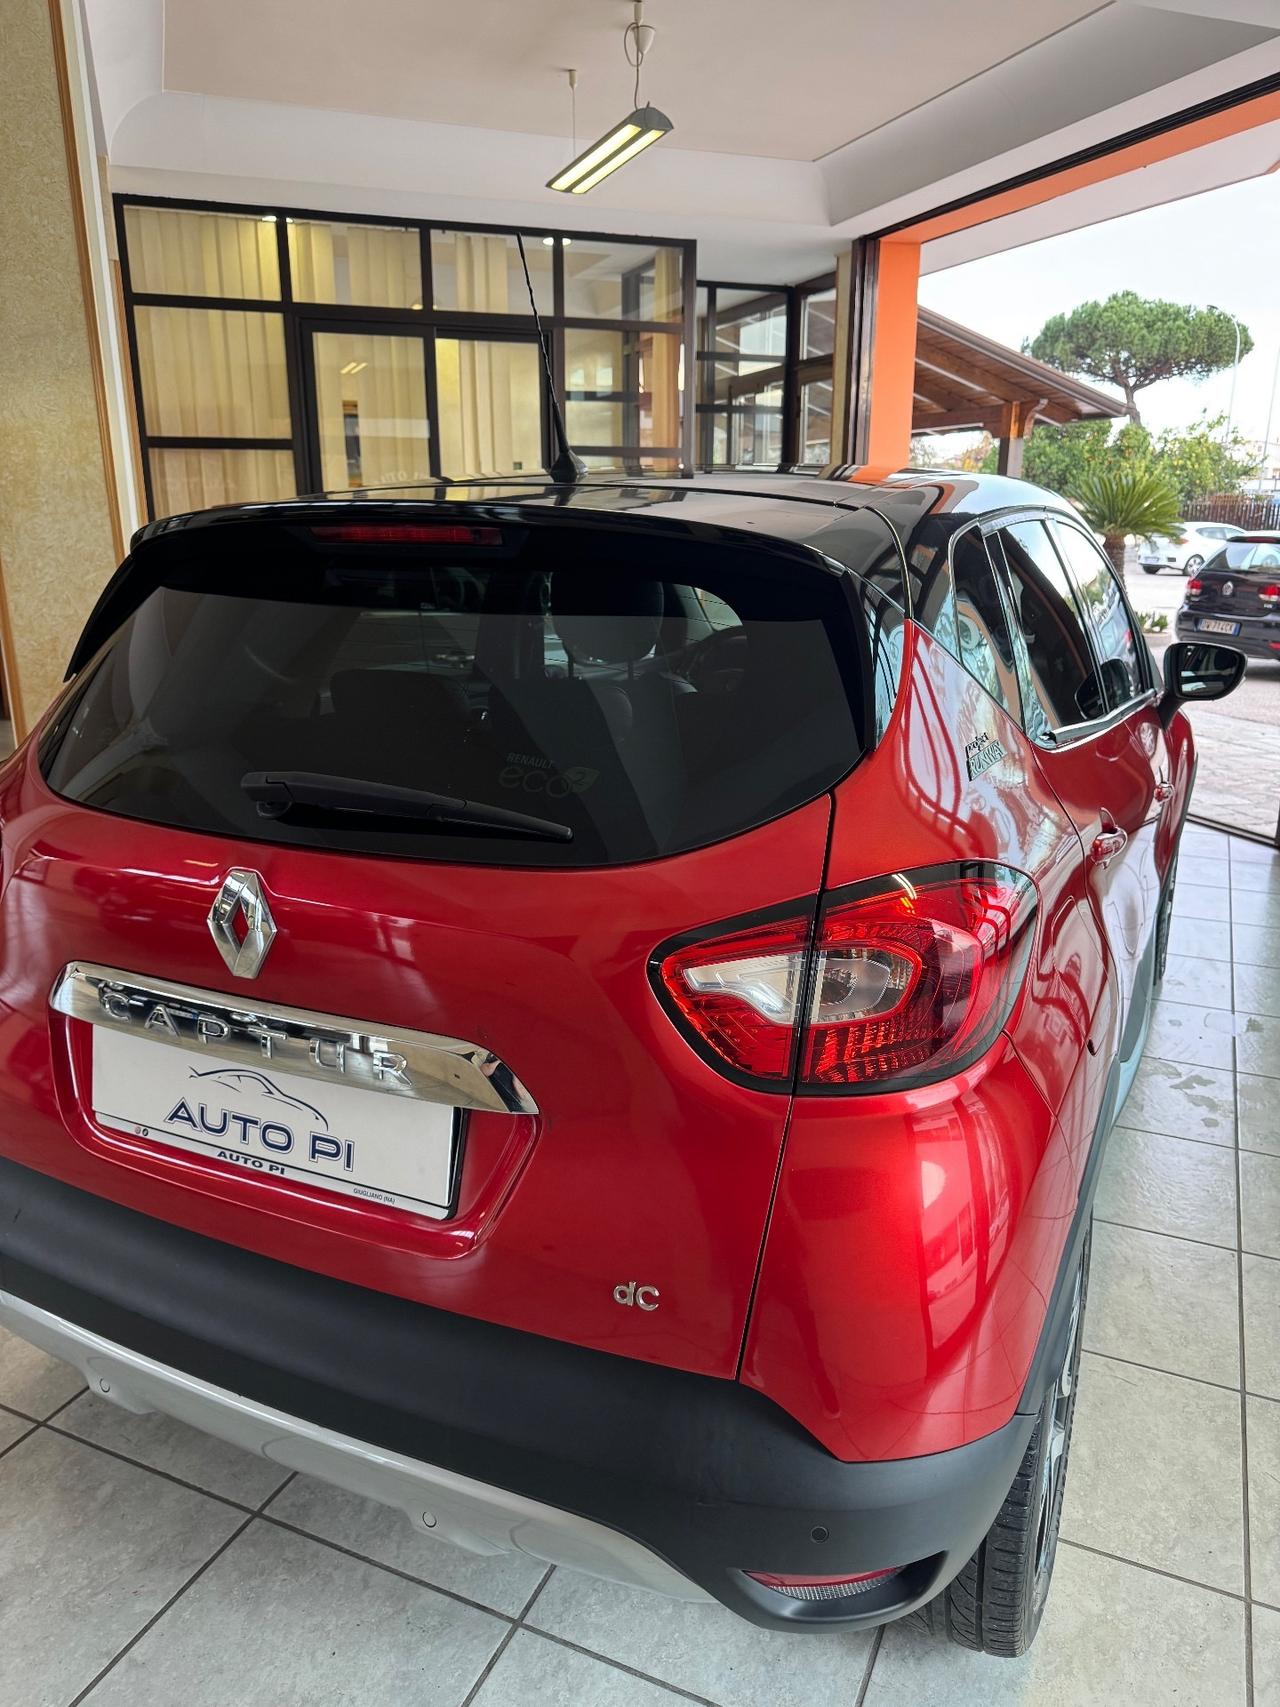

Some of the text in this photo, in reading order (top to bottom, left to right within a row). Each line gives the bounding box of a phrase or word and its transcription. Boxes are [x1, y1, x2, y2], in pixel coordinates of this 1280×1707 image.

[506, 752, 554, 769] RENAULT
[98, 988, 412, 1086] CAPTUR
[164, 1097, 355, 1172] AUTO PI
[217, 1150, 286, 1176] AUTO PI
